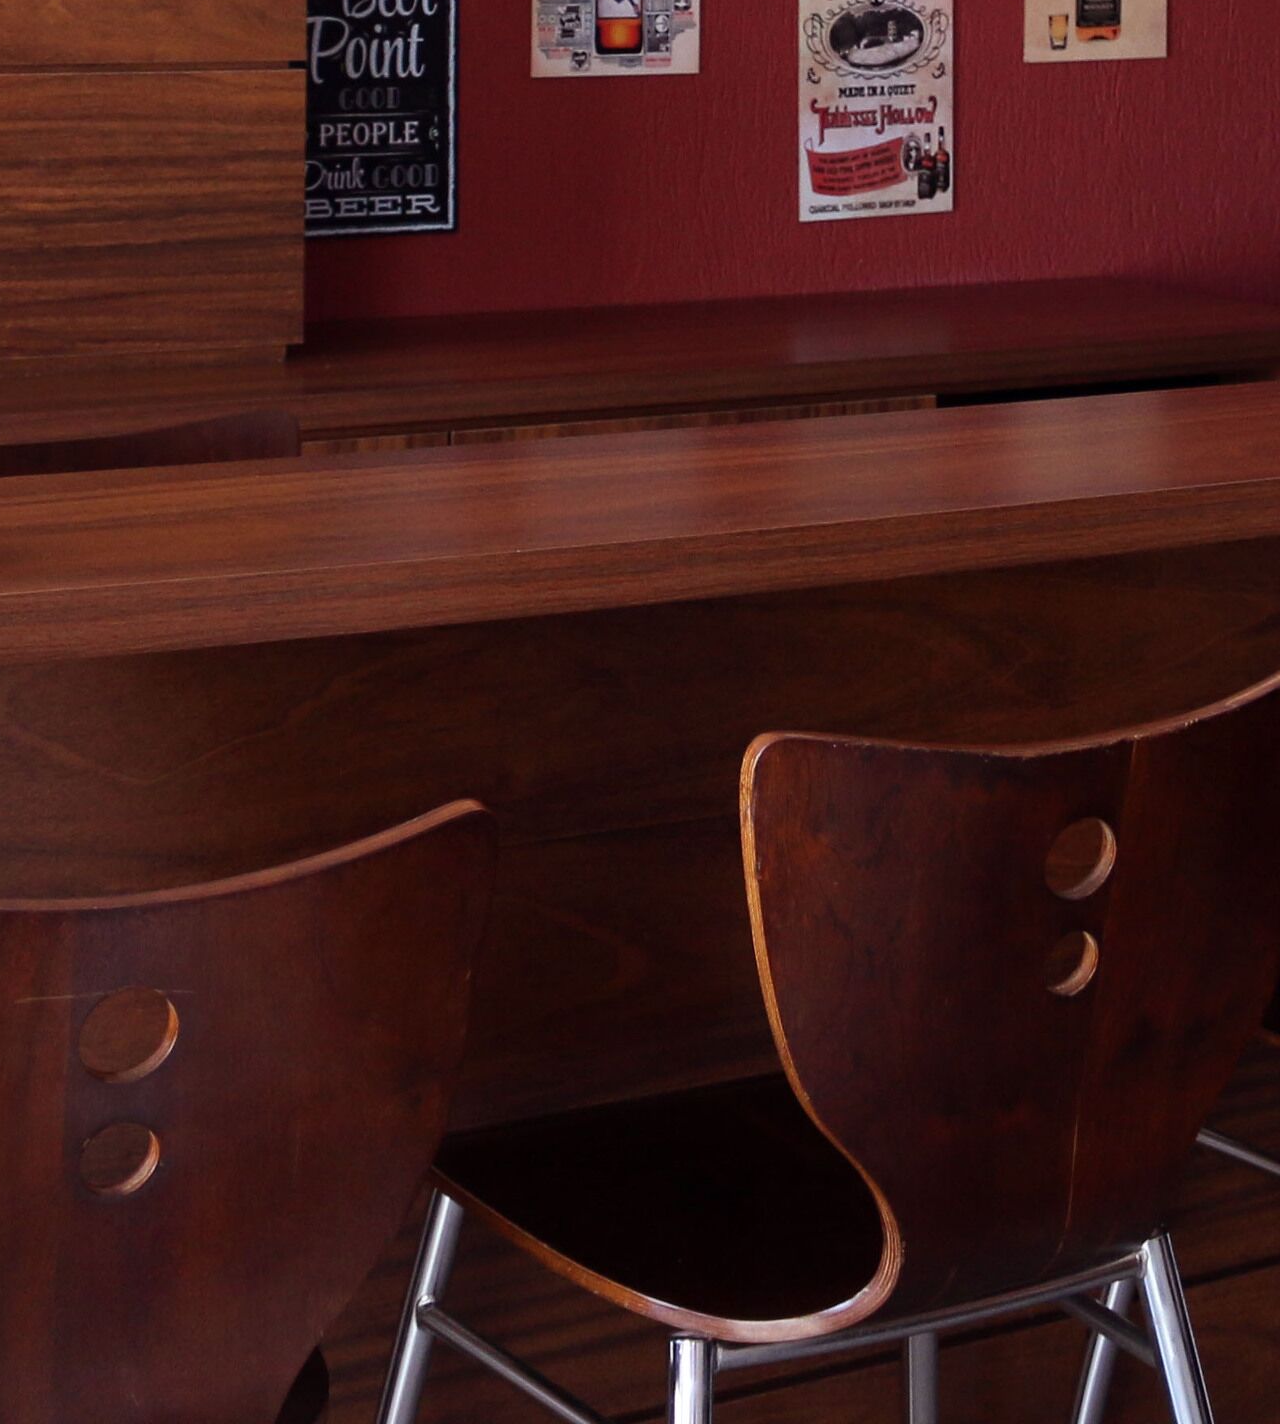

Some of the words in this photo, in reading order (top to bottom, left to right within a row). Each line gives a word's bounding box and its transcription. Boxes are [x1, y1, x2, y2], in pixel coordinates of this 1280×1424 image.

[308, 14, 425, 84] Point
[838, 86, 866, 98] MADE
[867, 86, 879, 97] IN
[880, 85, 887, 96] A
[887, 84, 917, 97] QUIET
[875, 95, 938, 135] HOLLOW
[320, 121, 420, 147] PEOPLE
[372, 163, 439, 188] GOOD
[304, 194, 440, 219] BEER
